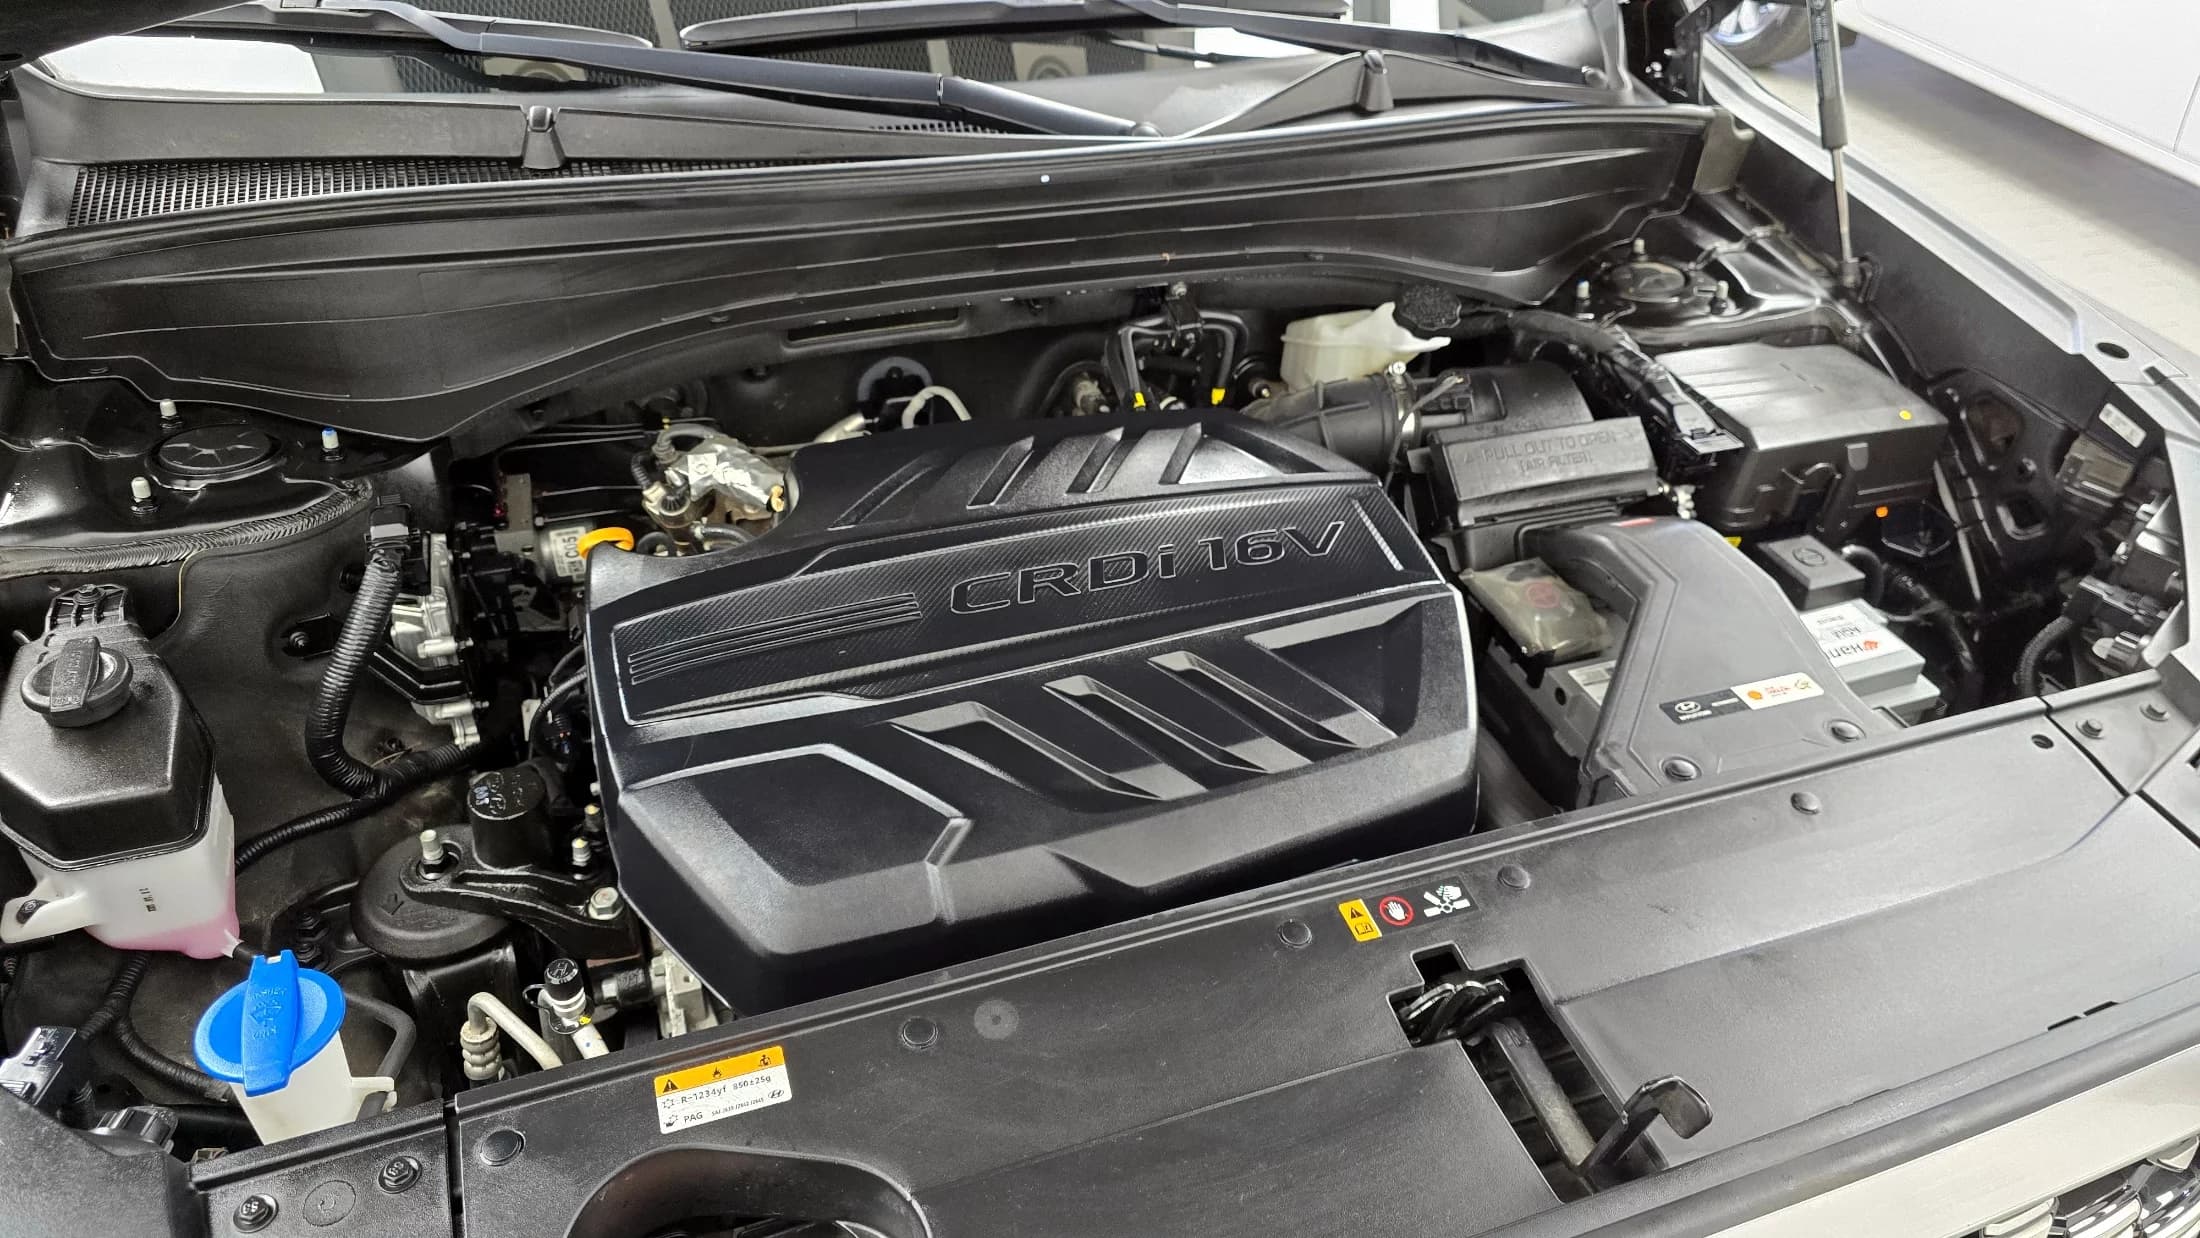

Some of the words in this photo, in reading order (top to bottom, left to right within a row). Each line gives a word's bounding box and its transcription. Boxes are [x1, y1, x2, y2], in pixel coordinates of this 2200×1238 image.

[1524, 437, 1556, 455] OUT
[1556, 434, 1577, 451] TO
[950, 544, 1177, 615] CRDi
[1199, 520, 1345, 571] 16V
[681, 1085, 727, 1104] R-1234yf
[683, 1111, 704, 1124] PAG
